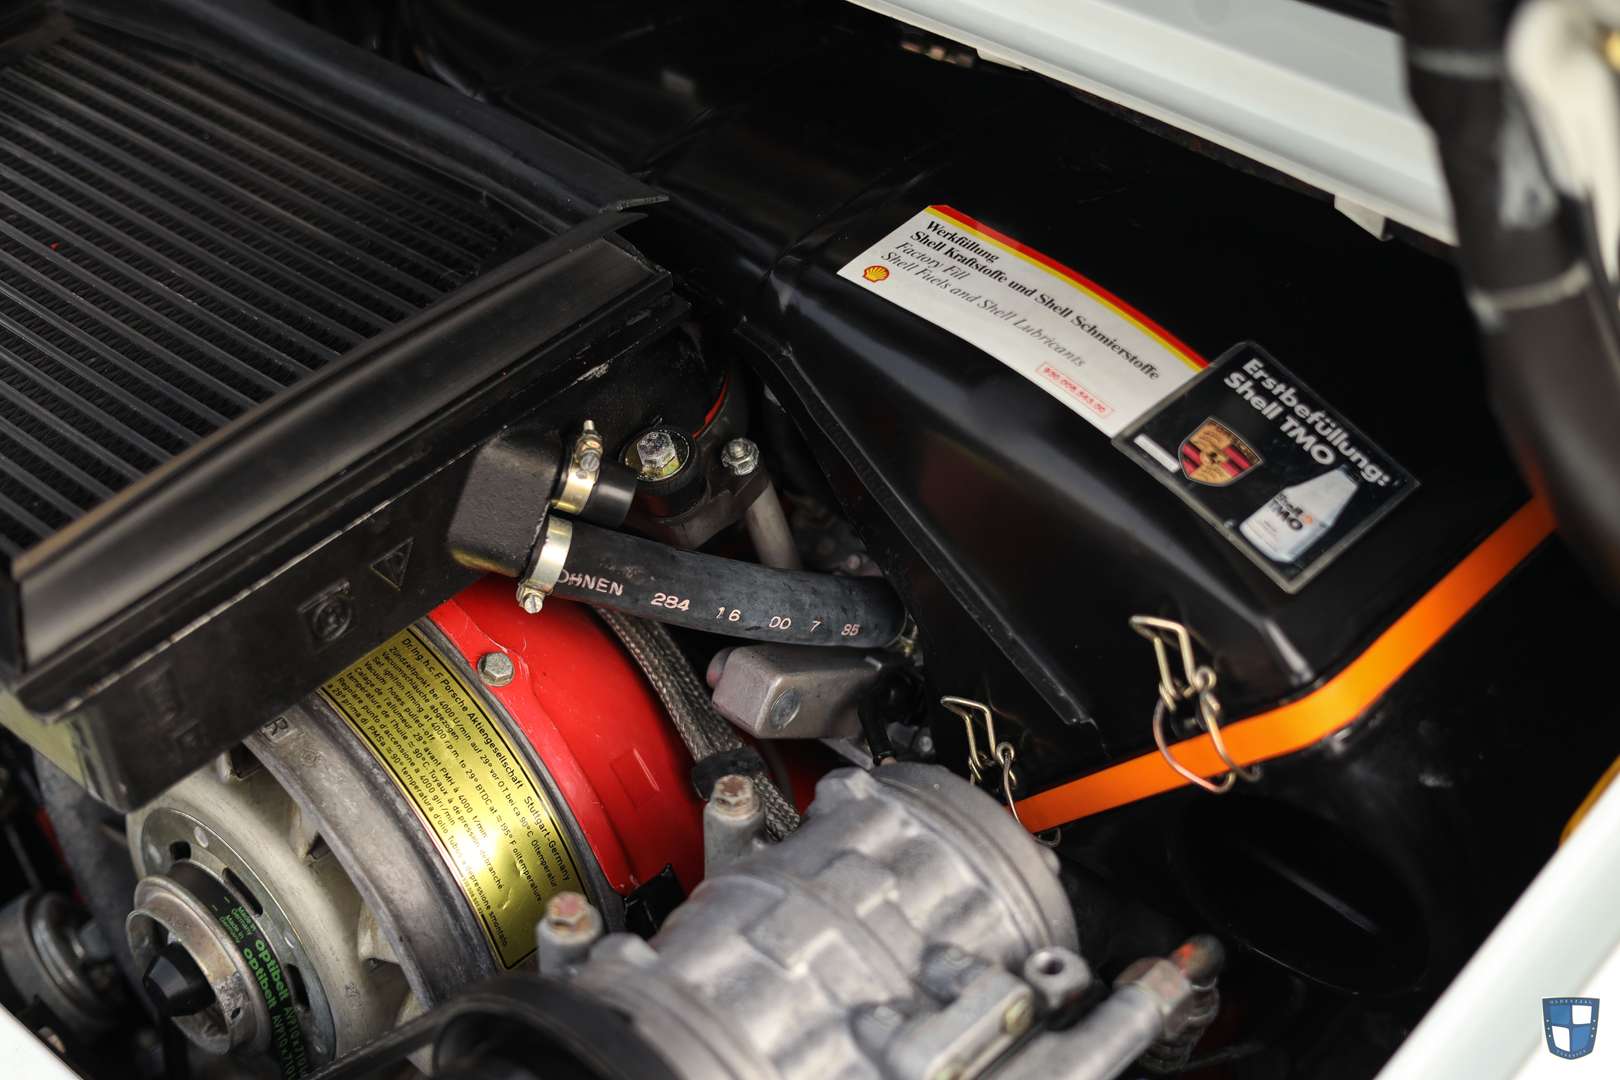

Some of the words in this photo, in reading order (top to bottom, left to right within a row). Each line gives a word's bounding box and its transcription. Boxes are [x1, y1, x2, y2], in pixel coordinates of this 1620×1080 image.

[896, 242, 943, 269] Factory
[941, 265, 971, 280] Fill
[926, 220, 1000, 263] Werkfüllung
[881, 251, 918, 272] Shell
[915, 268, 952, 290] Fuels
[950, 286, 981, 303] and
[977, 299, 1017, 321] Shell
[1013, 319, 1086, 368] Lubricants
[910, 231, 945, 252] Shell
[944, 247, 1007, 283] Kraftstoffe
[1008, 280, 1037, 297] und
[1034, 294, 1073, 318] Shell
[1070, 315, 1159, 380] Schmierstoffe
[1224, 371, 1284, 421] Shell
[1280, 415, 1336, 465] TMO
[1242, 358, 1391, 487] Erstbefüllung:
[650, 592, 690, 611] 284
[386, 685, 406, 706] hoses
[428, 687, 440, 700] bei
[438, 700, 455, 718] 4000
[469, 741, 482, 753] auf
[489, 768, 500, 780] vor
[360, 704, 380, 723] punto
[419, 774, 435, 793] 4000
[373, 687, 383, 696] de
[423, 746, 441, 766] avant
[439, 766, 455, 786] PMH
[457, 794, 473, 813] 4000
[380, 709, 390, 719] de
[428, 769, 448, 795] Tuyaux
[401, 766, 434, 812] temperatura
[404, 690, 424, 713] timing
[423, 713, 432, 721] at
[430, 721, 447, 739] 4000
[458, 759, 466, 768] to
[474, 783, 492, 805] BTDC
[439, 678, 468, 712] Porsche
[467, 712, 523, 789] Aktiengesellschaft
[523, 795, 570, 881] Stuttgart-Germany
[243, 947, 277, 1008] optibelt
[255, 939, 288, 1000] optibelt
